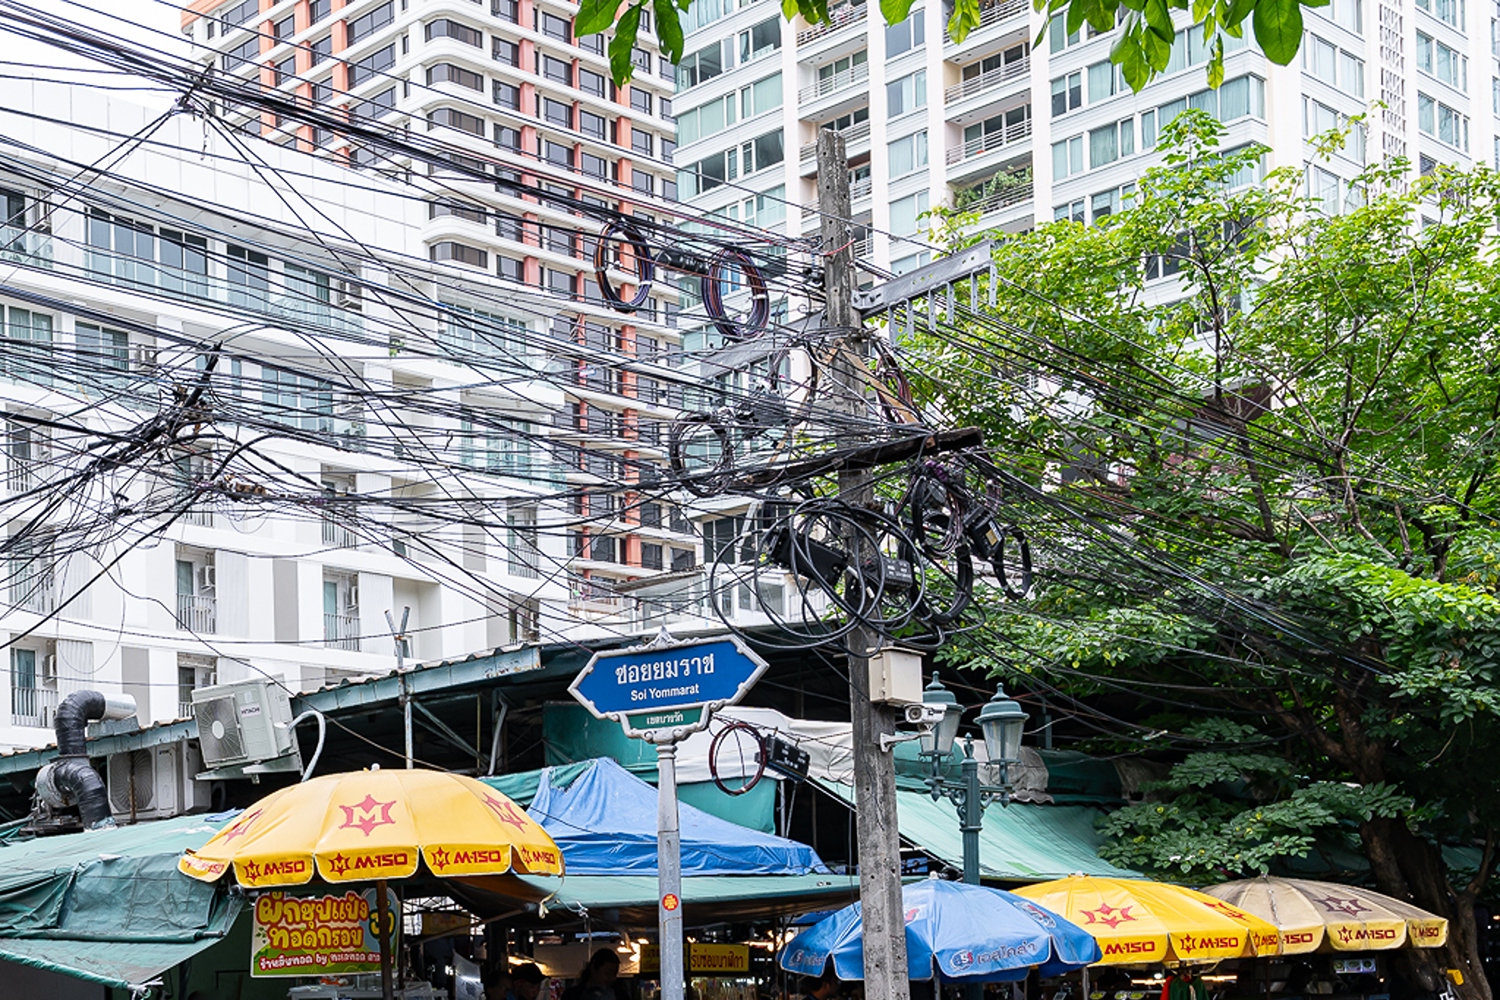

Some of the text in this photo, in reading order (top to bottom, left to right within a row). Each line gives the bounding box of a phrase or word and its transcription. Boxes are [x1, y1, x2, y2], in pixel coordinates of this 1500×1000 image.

[615, 653, 715, 685] ซอยยมราช
[631, 684, 700, 701] Soi Yommarat
[241, 707, 260, 715] HITACHI
[646, 711, 684, 725] เขตบางรัก
[354, 853, 408, 870] M-150
[454, 850, 502, 864] M-150
[533, 850, 556, 865] M-150
[263, 859, 306, 876] M-150
[269, 927, 363, 949] ทอดกรอบ
[1281, 932, 1314, 944] -150
[1355, 929, 1396, 940] M-150
[1104, 941, 1156, 955] M-150
[1199, 937, 1239, 949] M-150
[315, 952, 328, 964] by
[691, 947, 744, 968] รับซ่อมนาฬิกา
